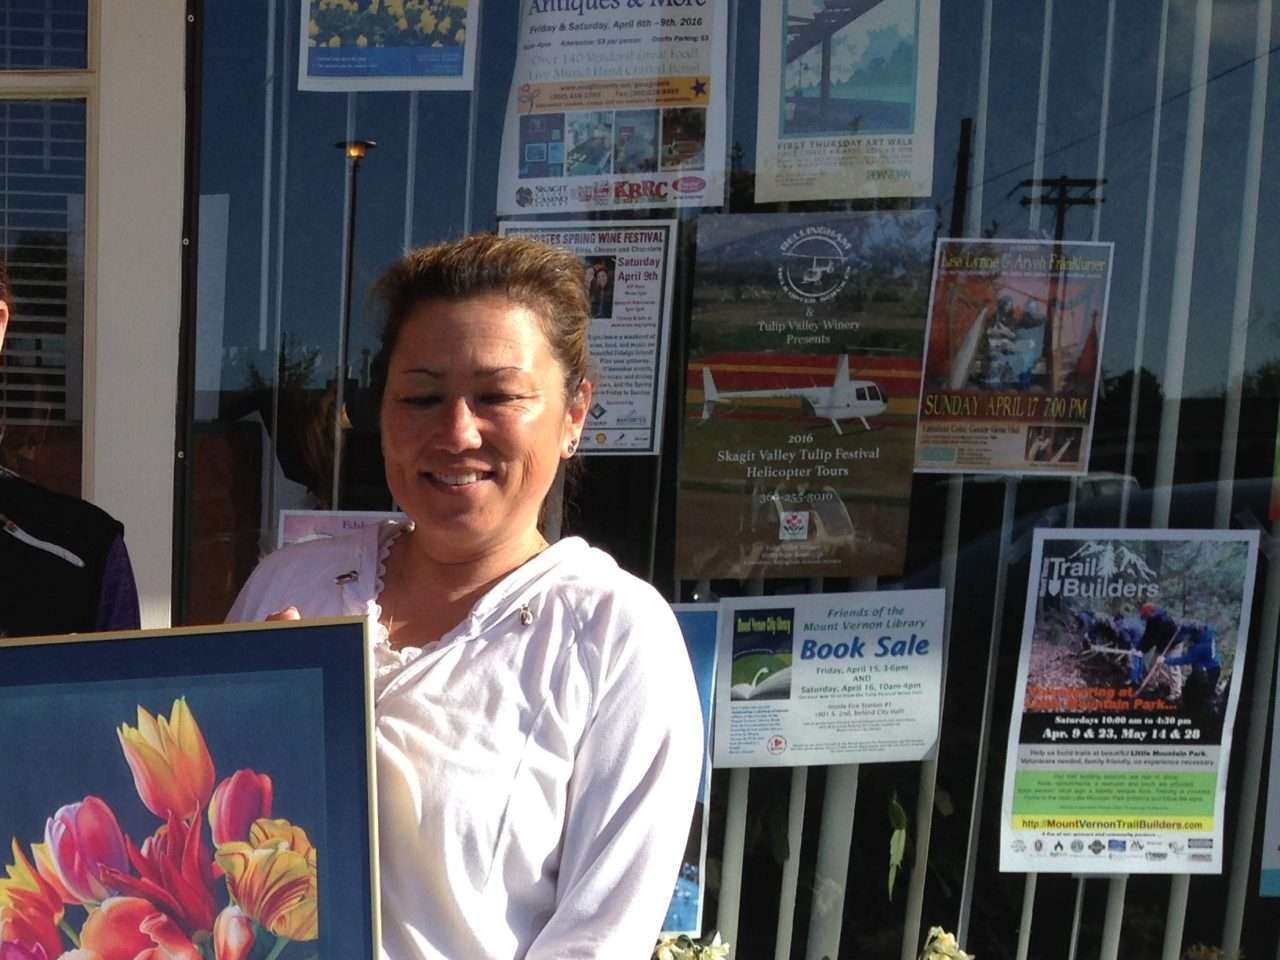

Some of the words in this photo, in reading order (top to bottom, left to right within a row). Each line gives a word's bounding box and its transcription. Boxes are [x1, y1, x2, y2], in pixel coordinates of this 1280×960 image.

[530, 25, 557, 34] Friday
[613, 19, 635, 30] April
[679, 17, 703, 26] 2016
[563, 232, 596, 245] SPRING
[598, 231, 622, 244] WINE
[624, 231, 663, 243] FESTIVAL
[617, 256, 660, 269] Saturday
[618, 271, 641, 283] April
[644, 271, 659, 281] 9th
[758, 320, 785, 334] Tulip
[788, 320, 819, 332] Valley
[823, 319, 860, 332] Winery
[786, 334, 831, 345] Presents
[924, 394, 978, 416] SUNDAY
[985, 396, 1024, 417] APRIL
[1027, 397, 1040, 417] 17
[1068, 398, 1089, 419] PM
[787, 432, 815, 443] 2016
[717, 449, 756, 465] Skagit
[759, 448, 796, 464] Valley
[799, 447, 833, 463] Tulip
[835, 447, 880, 461] Festival
[747, 465, 812, 480] Helicopter
[814, 464, 849, 478] Tours
[1050, 557, 1098, 577] Trail
[1063, 578, 1160, 598] Builders
[826, 607, 869, 619] Friends
[872, 606, 885, 618] of
[887, 606, 905, 617] the
[803, 621, 839, 633] Mount
[842, 620, 884, 632] Vernon
[886, 618, 928, 632] Library
[800, 636, 865, 661] Book
[874, 633, 931, 659] Sale
[816, 666, 844, 675] Friday,
[846, 665, 867, 674] April
[801, 684, 839, 694] Saturday,
[841, 683, 862, 694] April
[1054, 716, 1099, 727] Saturdays
[1101, 716, 1127, 726] 10:00
[1128, 718, 1142, 726] am
[1144, 717, 1154, 726] to
[1156, 716, 1176, 726] 4:30
[1178, 718, 1192, 728] pm
[1042, 728, 1068, 741] Apr.
[1071, 728, 1081, 739] 9
[1083, 728, 1095, 740] &
[1098, 728, 1118, 741] 23,
[1120, 728, 1148, 742] May
[1151, 728, 1167, 740] 14
[1169, 729, 1181, 740] &
[1184, 728, 1200, 740] 28
[1022, 819, 1203, 831] http://MountVernonTrailBuilders.com
